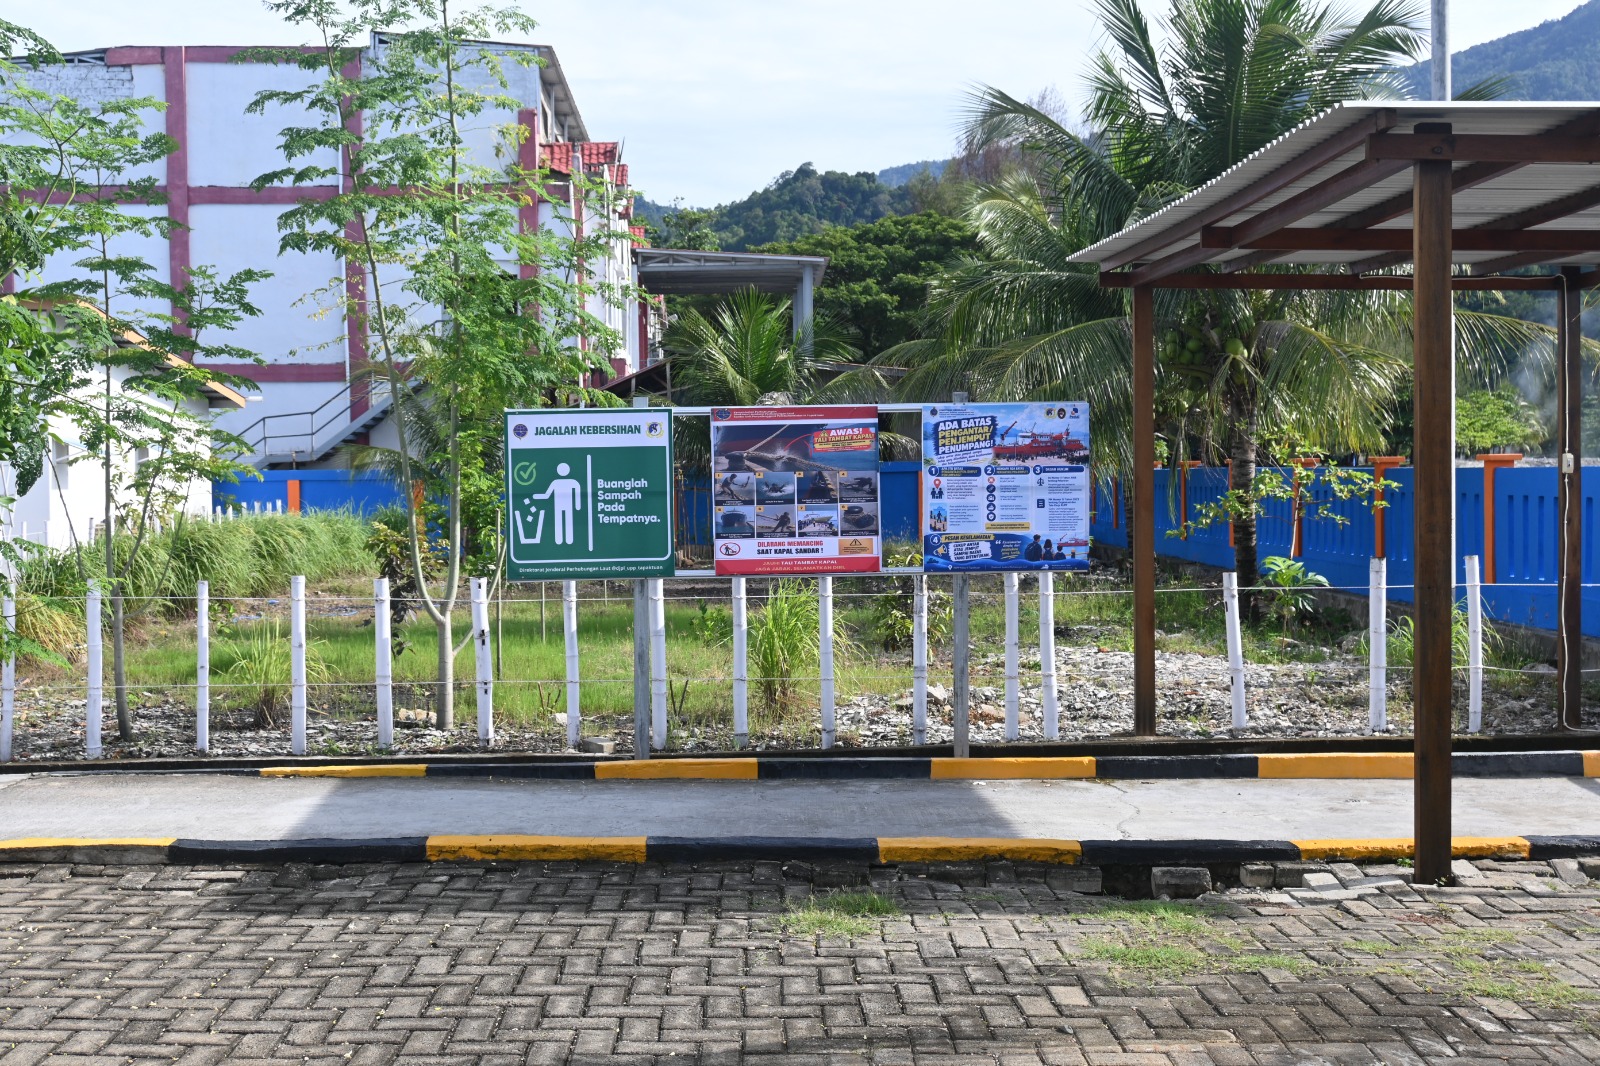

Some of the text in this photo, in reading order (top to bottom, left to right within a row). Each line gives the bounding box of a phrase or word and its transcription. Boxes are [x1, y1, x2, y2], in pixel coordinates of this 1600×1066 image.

[938, 417, 991, 431] ADA BATAS
[534, 425, 641, 436] JAGALAH KEBERSIHAN
[830, 428, 862, 436] AWAS!
[939, 426, 993, 438] PENGANTAR/
[939, 433, 990, 446] PENJEMPUT
[939, 440, 993, 454] PENUMPANG!
[597, 478, 648, 490] Buanglah
[597, 490, 642, 502] Sampah
[597, 502, 625, 512] Pada
[597, 513, 661, 525] Tempatnya.
